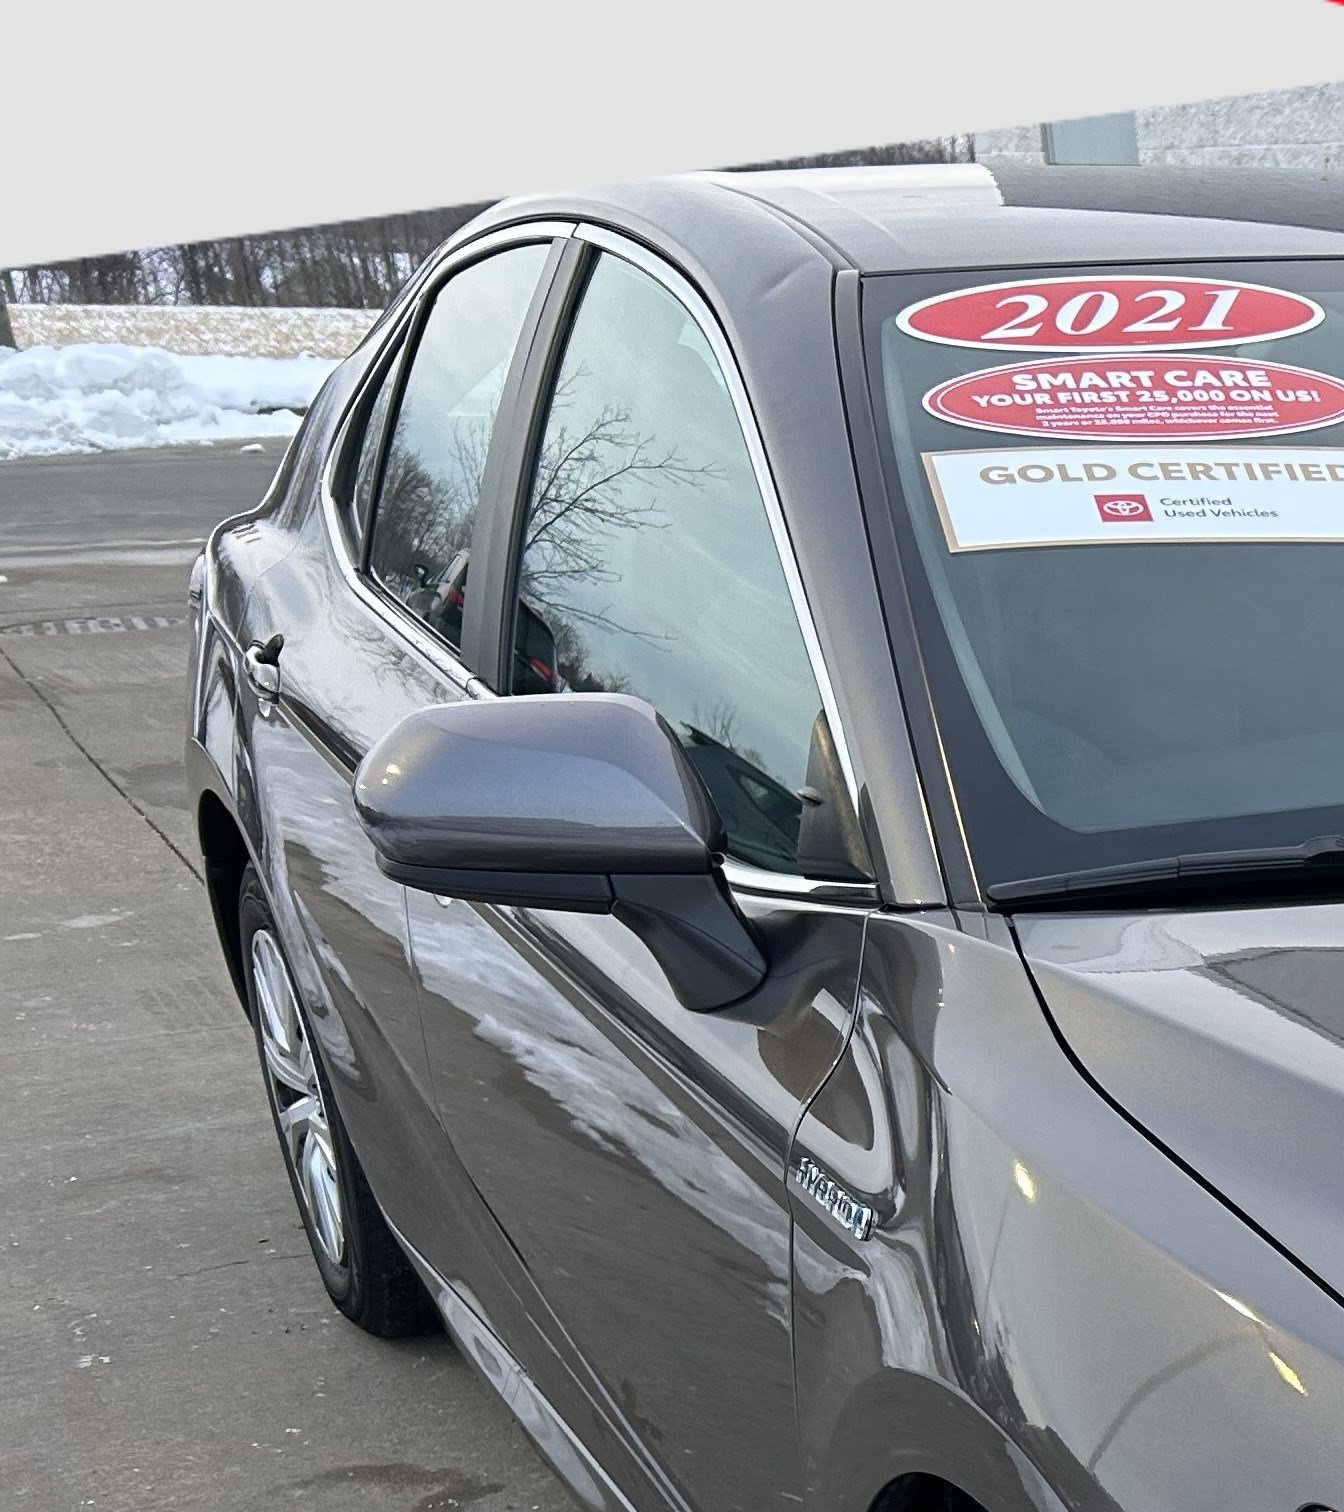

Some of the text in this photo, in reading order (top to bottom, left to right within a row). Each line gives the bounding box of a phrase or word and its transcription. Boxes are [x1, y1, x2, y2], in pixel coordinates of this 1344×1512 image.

[981, 288, 1242, 340] 2021
[1011, 369, 1272, 391] SMART CARE
[971, 388, 1322, 408] YOUR FIRST 25,000 ON US!
[979, 462, 1117, 485] GOLD
[1159, 496, 1233, 507] Certified
[1163, 508, 1279, 518] Used Vehicles
